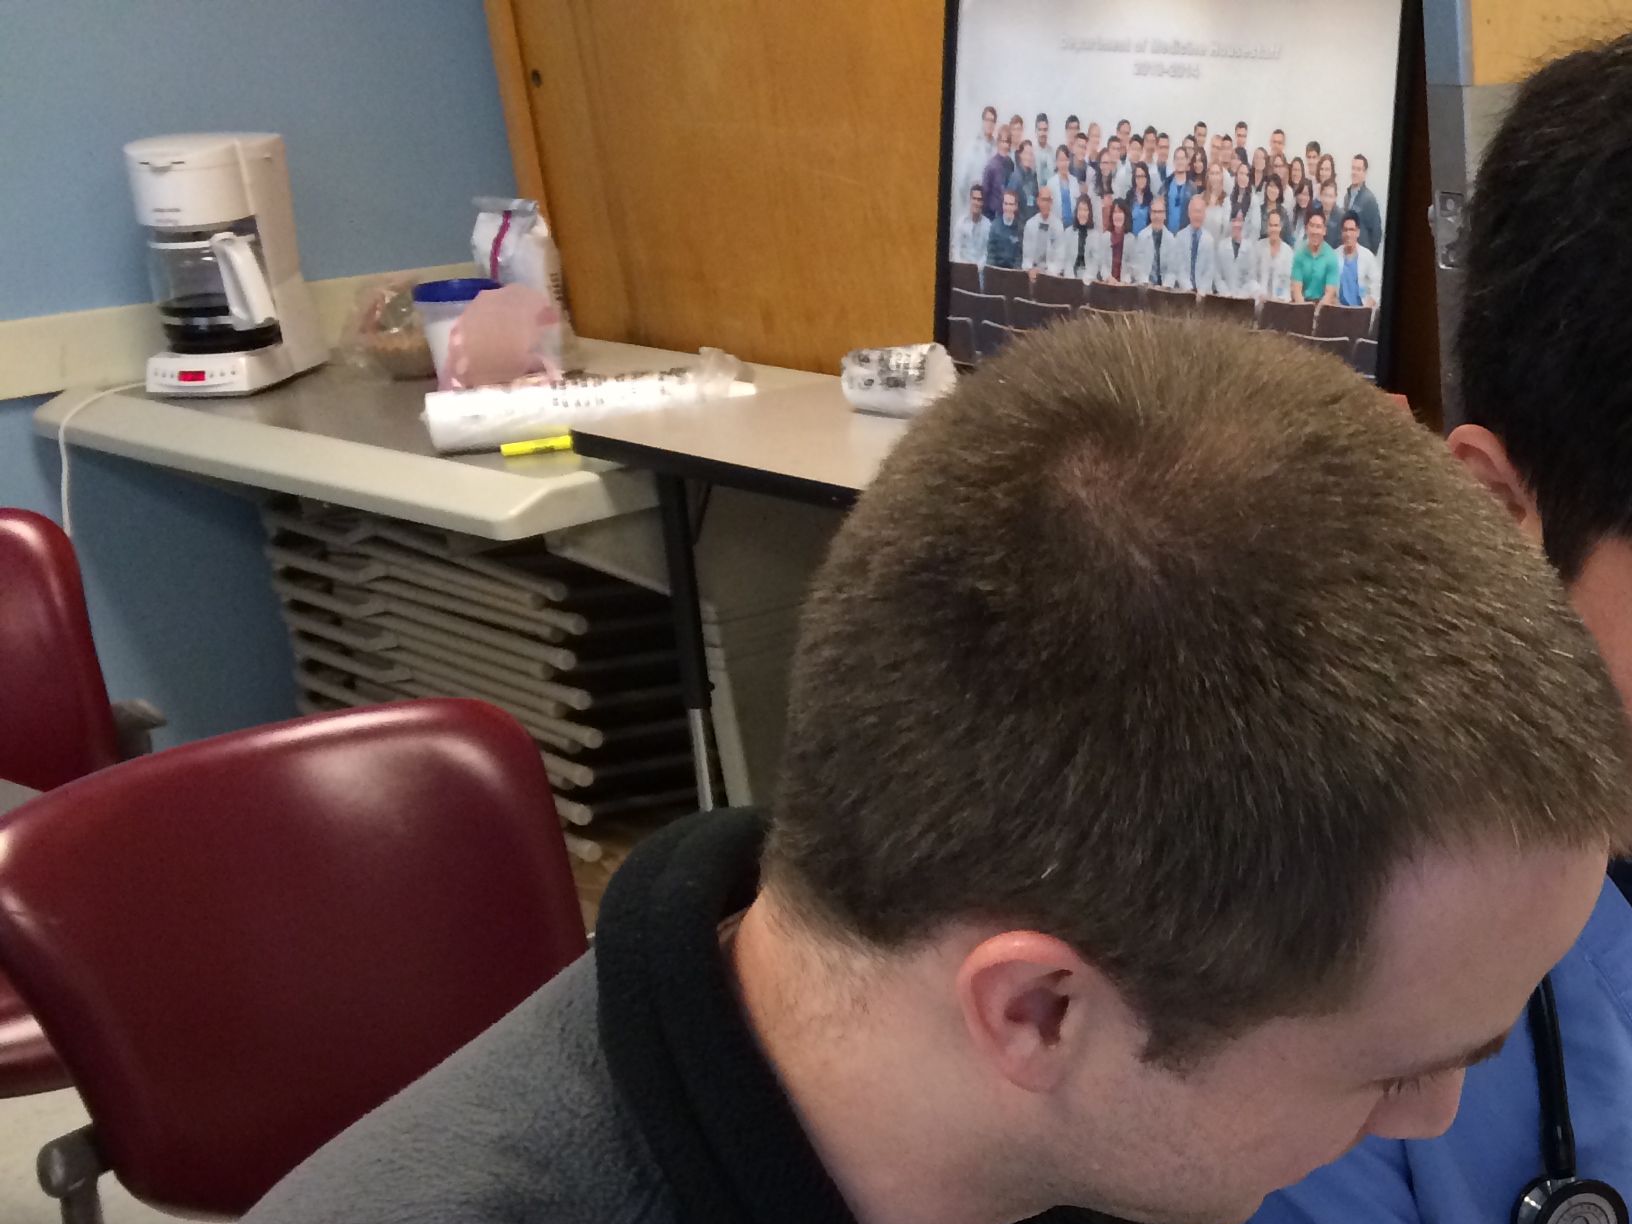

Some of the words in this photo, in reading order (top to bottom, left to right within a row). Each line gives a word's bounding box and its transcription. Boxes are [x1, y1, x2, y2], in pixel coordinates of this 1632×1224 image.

[1060, 35, 1130, 55] Department
[1134, 38, 1147, 53] of
[1151, 38, 1206, 56] Medicine
